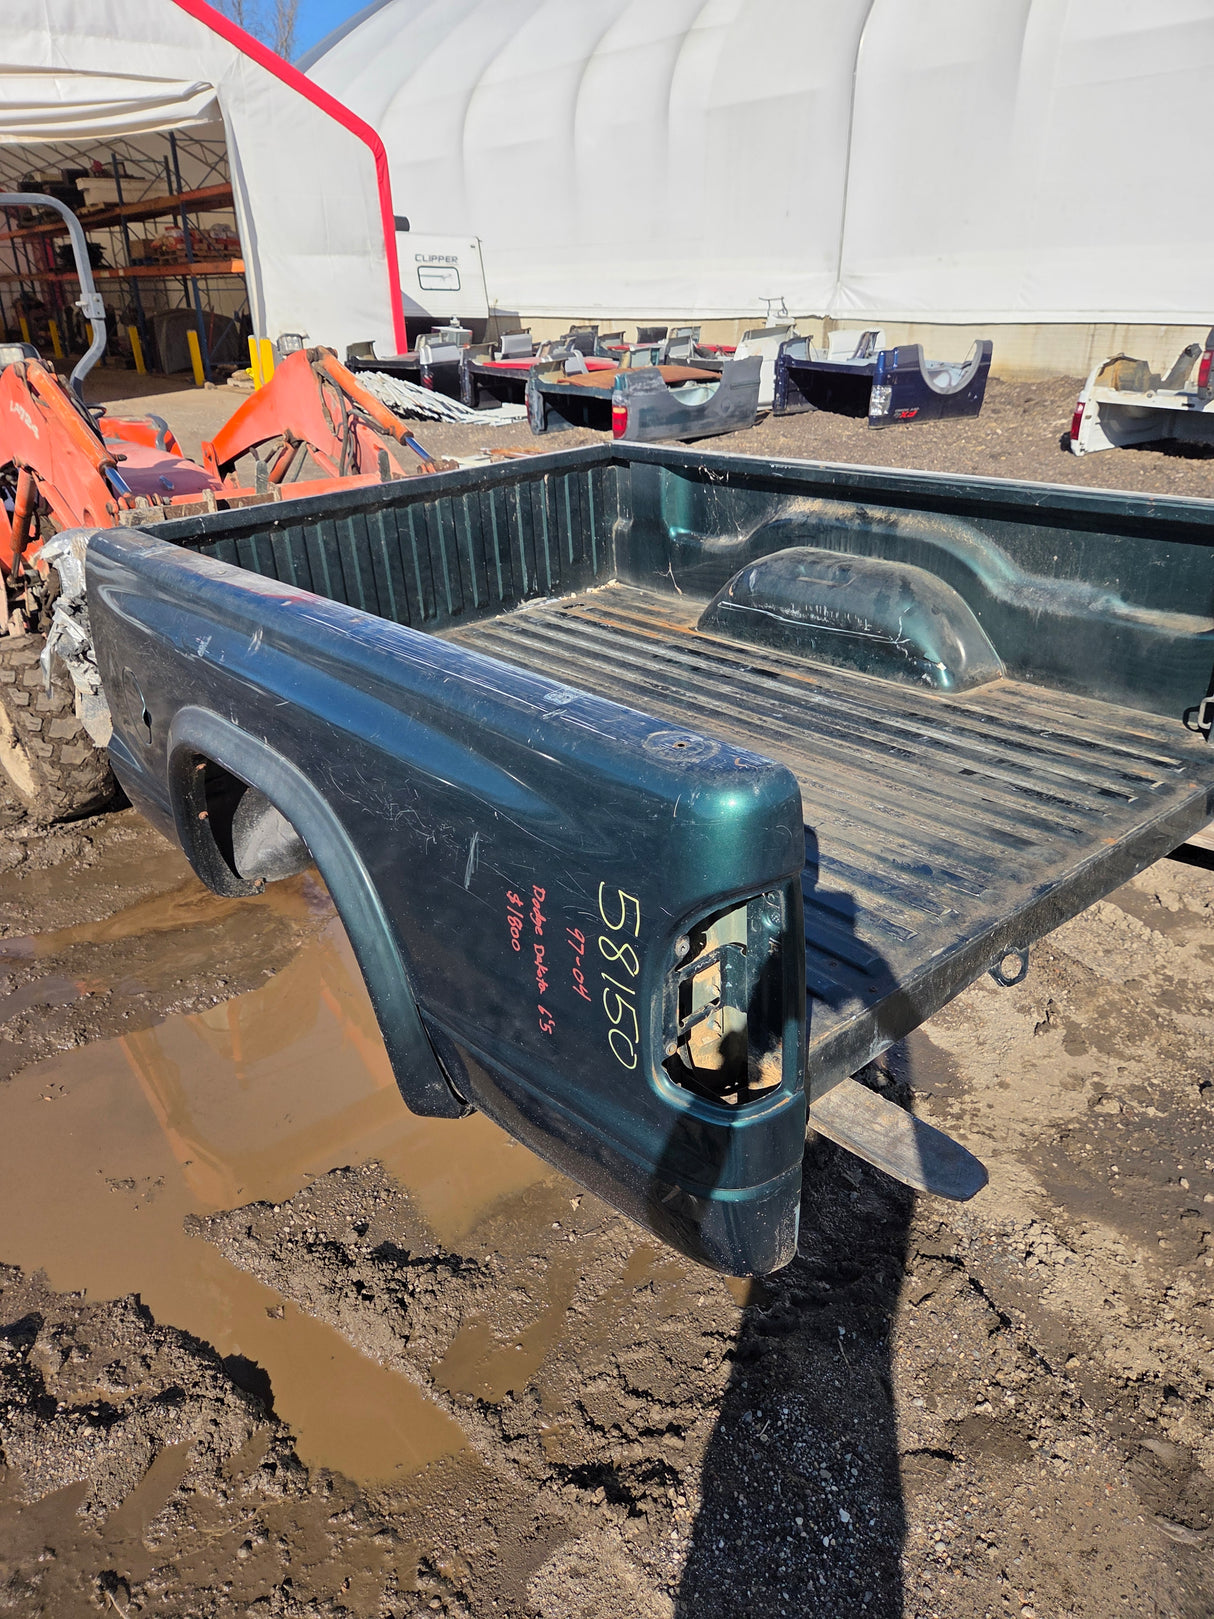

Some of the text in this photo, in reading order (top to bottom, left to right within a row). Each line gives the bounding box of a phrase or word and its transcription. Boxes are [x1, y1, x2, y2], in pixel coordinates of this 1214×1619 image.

[414, 253, 459, 264] CLIPPER
[506, 890, 524, 952] $1800
[529, 884, 547, 936] Dodge
[533, 943, 549, 995] Dakota
[566, 927, 592, 1002] 97-04
[598, 881, 640, 1070] 58150
